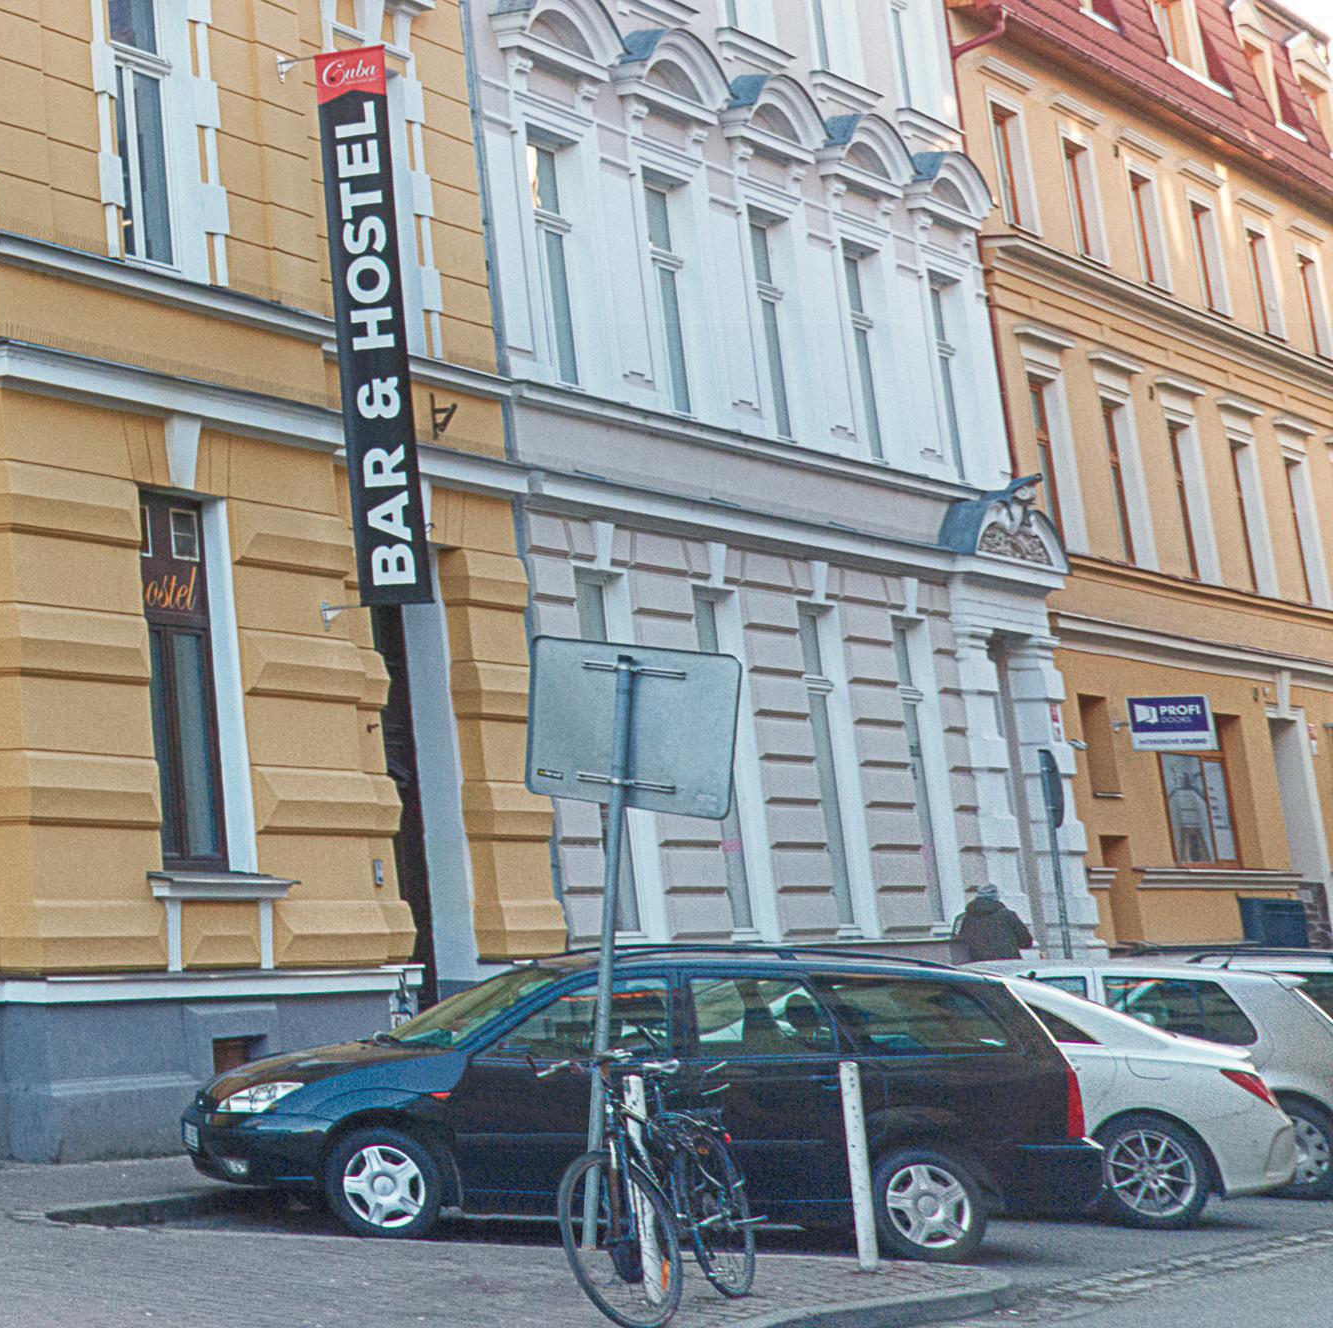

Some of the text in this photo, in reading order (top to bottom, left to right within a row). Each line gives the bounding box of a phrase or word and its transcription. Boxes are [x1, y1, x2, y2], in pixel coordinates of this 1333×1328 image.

[322, 59, 376, 88] Cuba
[334, 100, 395, 351] HOSTEL
[356, 376, 401, 420] &
[363, 444, 416, 586] BAR
[1159, 704, 1201, 716] PROFI
